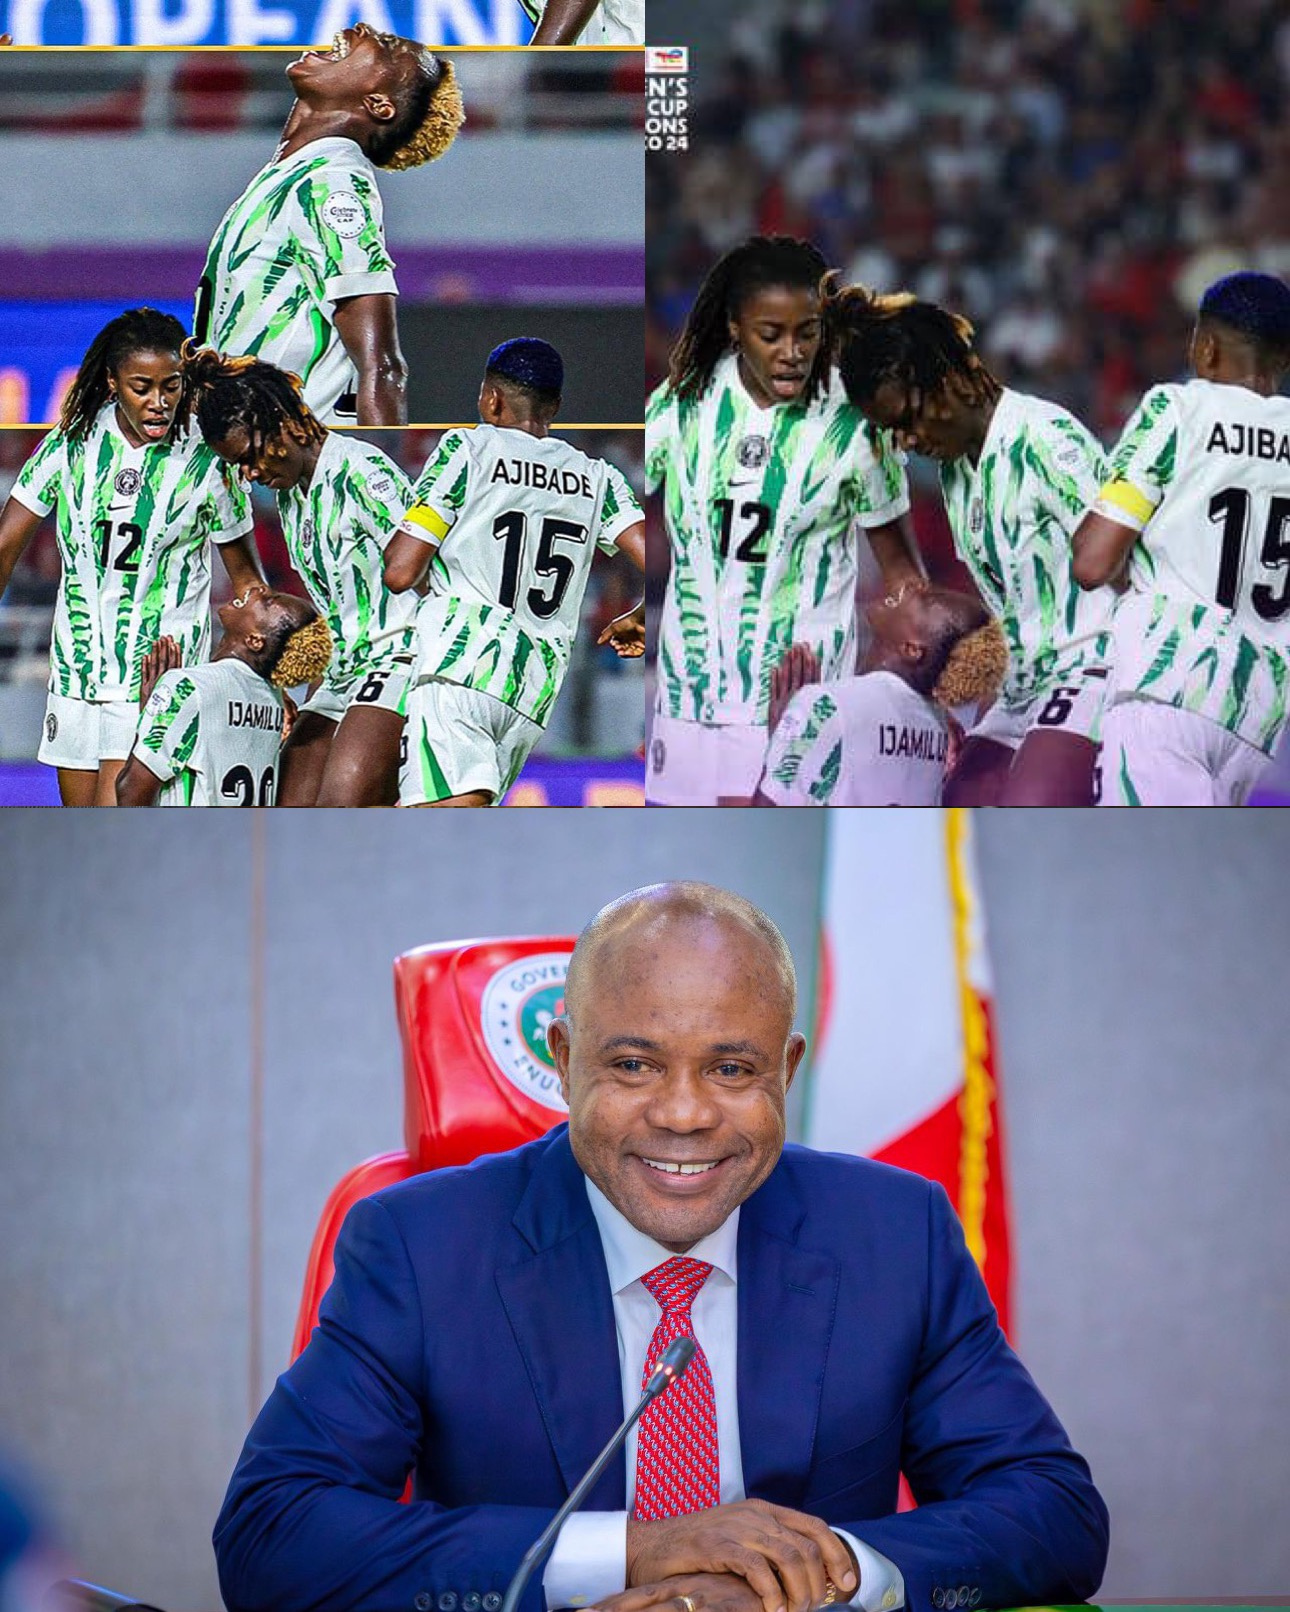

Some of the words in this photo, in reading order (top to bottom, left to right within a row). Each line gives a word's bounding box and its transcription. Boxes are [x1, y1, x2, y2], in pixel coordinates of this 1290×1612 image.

[491, 458, 594, 499] AJIBADE
[95, 519, 142, 572] 12
[713, 499, 770, 563] 12
[492, 510, 589, 621] 15
[355, 671, 390, 703] 6
[1037, 687, 1082, 726] 6
